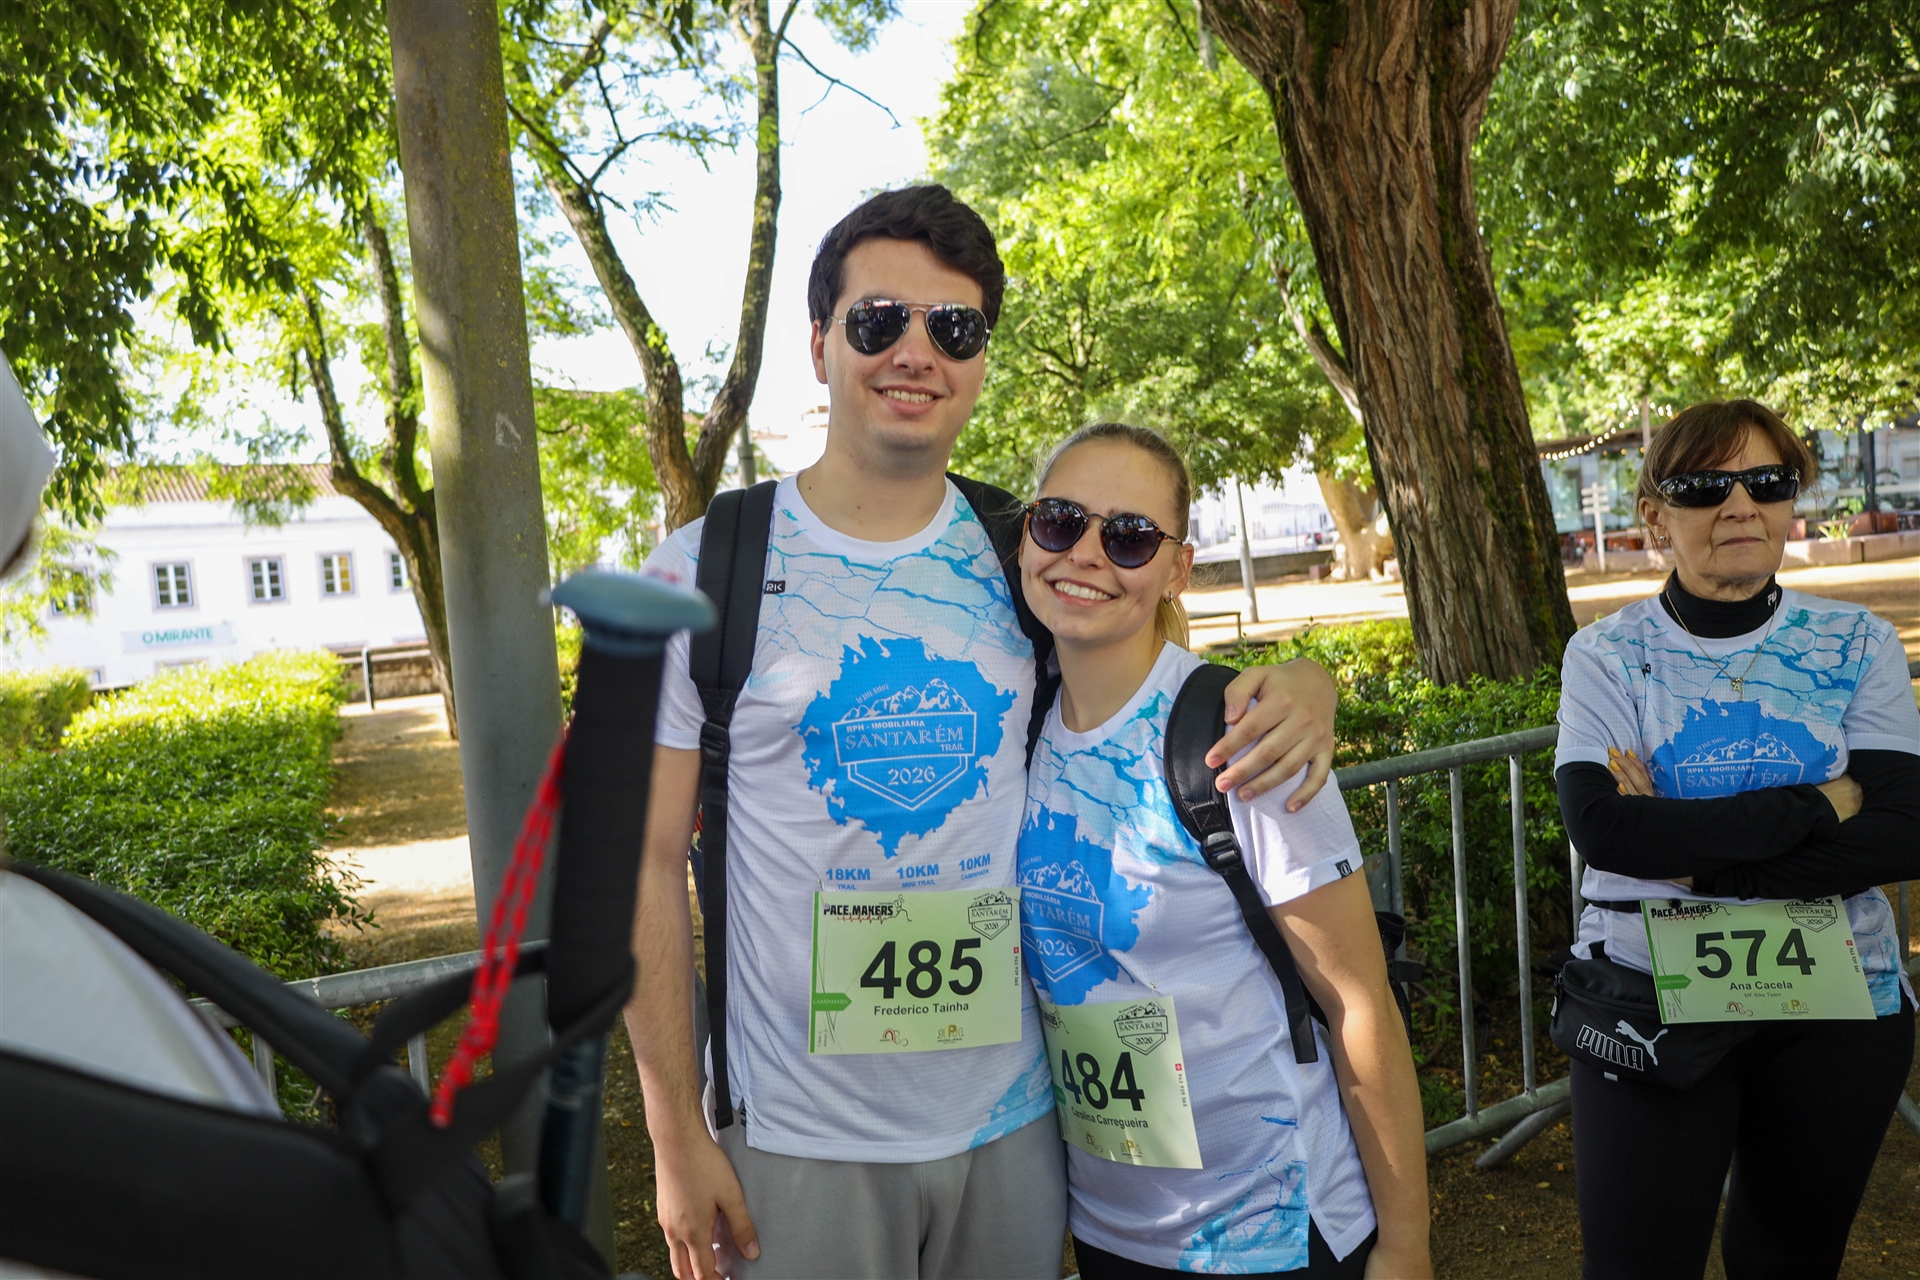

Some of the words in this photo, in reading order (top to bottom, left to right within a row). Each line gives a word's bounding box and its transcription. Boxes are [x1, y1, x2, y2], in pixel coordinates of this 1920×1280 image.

[142, 631, 154, 644] O
[155, 627, 214, 643] MIRANTE
[846, 724, 865, 733] RPH
[871, 719, 925, 730] IMOBILIÁRIA
[845, 724, 964, 750] SANTARÉM
[940, 743, 964, 752] TRAIL
[888, 765, 936, 786] 2026
[958, 853, 991, 871] 10KM
[826, 868, 871, 881] 18KM
[896, 863, 940, 879] 10KM
[902, 881, 916, 889] MINI
[917, 879, 936, 887] TRAIL
[1025, 890, 1061, 905] IMOBILIÁRIA
[1072, 926, 1093, 938] TRAIL
[1035, 938, 1077, 957] 2026
[1695, 928, 1817, 979] 574
[860, 937, 983, 999] 485
[1729, 982, 1752, 991] Ana
[1754, 980, 1794, 990] Cacela
[874, 1005, 929, 1016] Frederico
[1576, 1024, 1644, 1071] PUMA
[1061, 1049, 1146, 1112] 484
[1071, 1106, 1096, 1123] Carolina
[1096, 1114, 1149, 1130] Carregueira
